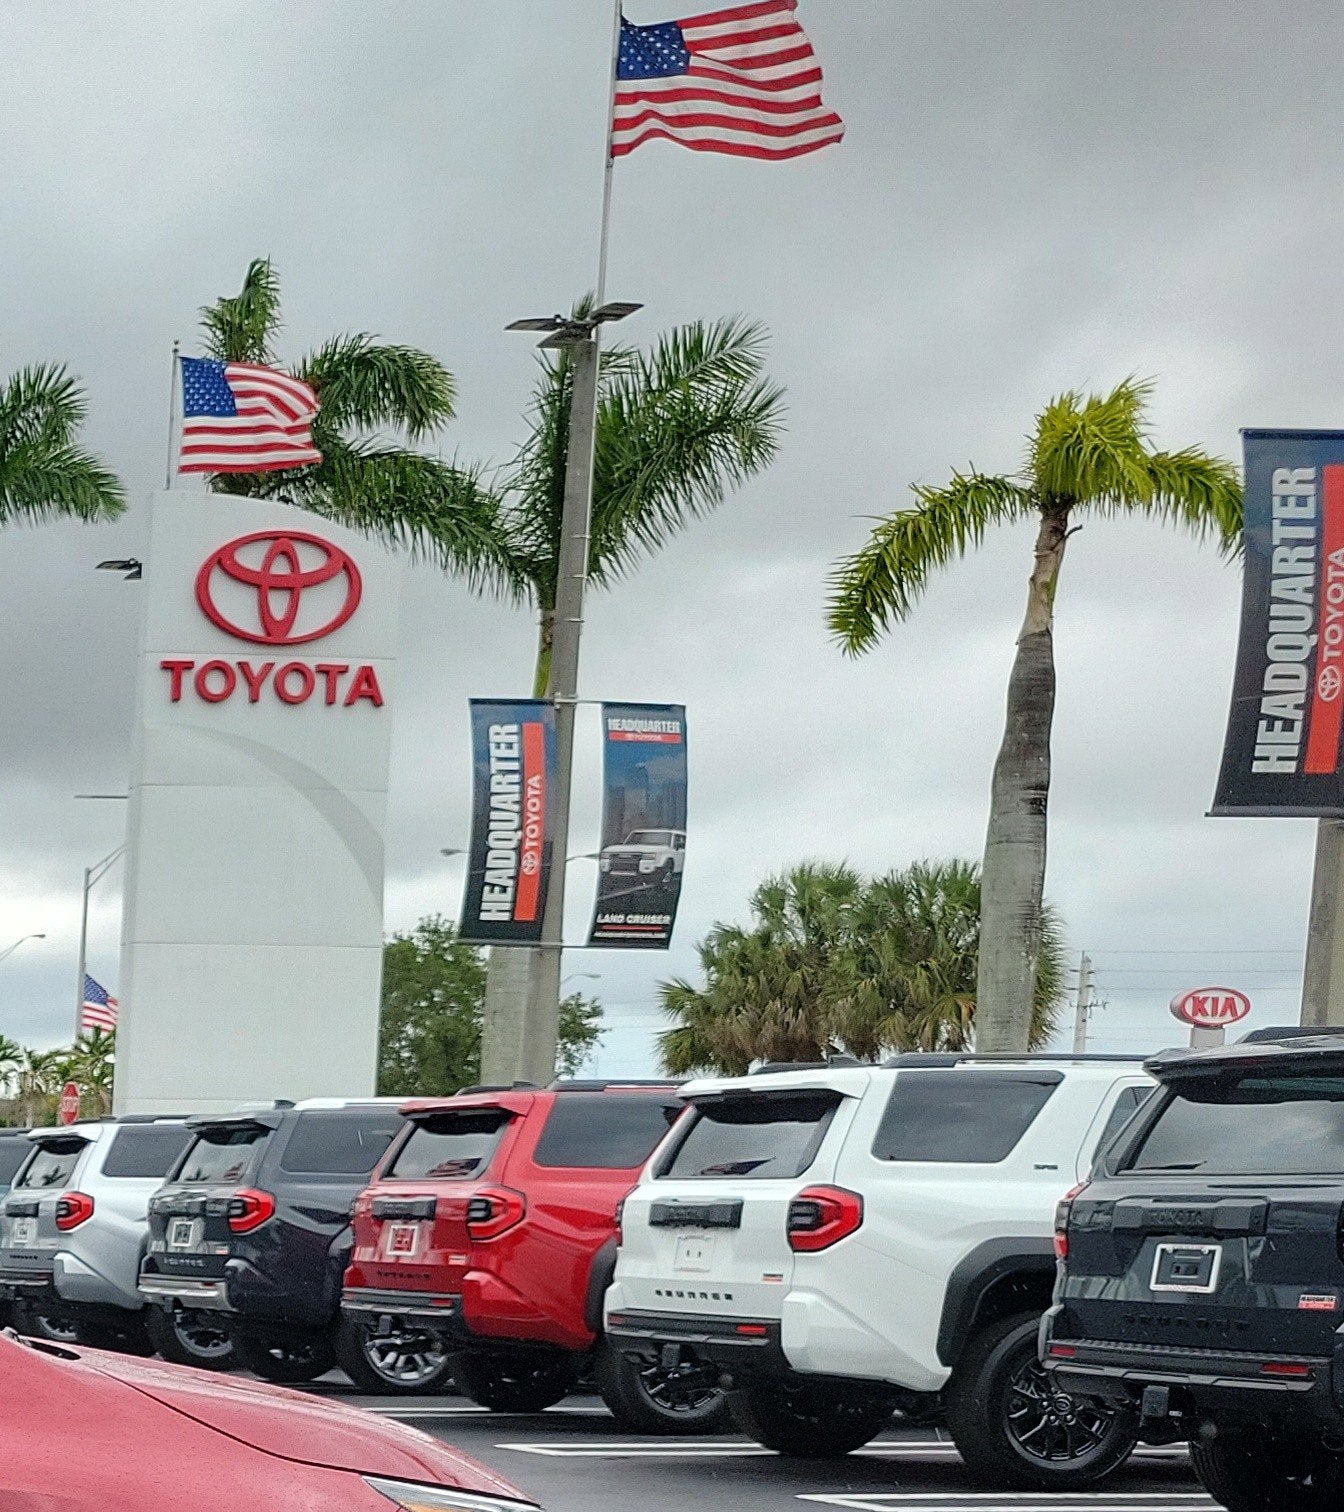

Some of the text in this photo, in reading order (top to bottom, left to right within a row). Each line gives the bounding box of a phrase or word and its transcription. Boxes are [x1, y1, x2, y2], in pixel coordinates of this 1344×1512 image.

[1252, 467, 1318, 774] HEADQUARTER
[1322, 549, 1344, 662] TOYOTA
[160, 660, 385, 707] TOYOTA
[479, 723, 523, 922] HEADQUARTER
[524, 774, 543, 850] TOYOTA
[1192, 996, 1239, 1017] KIA
